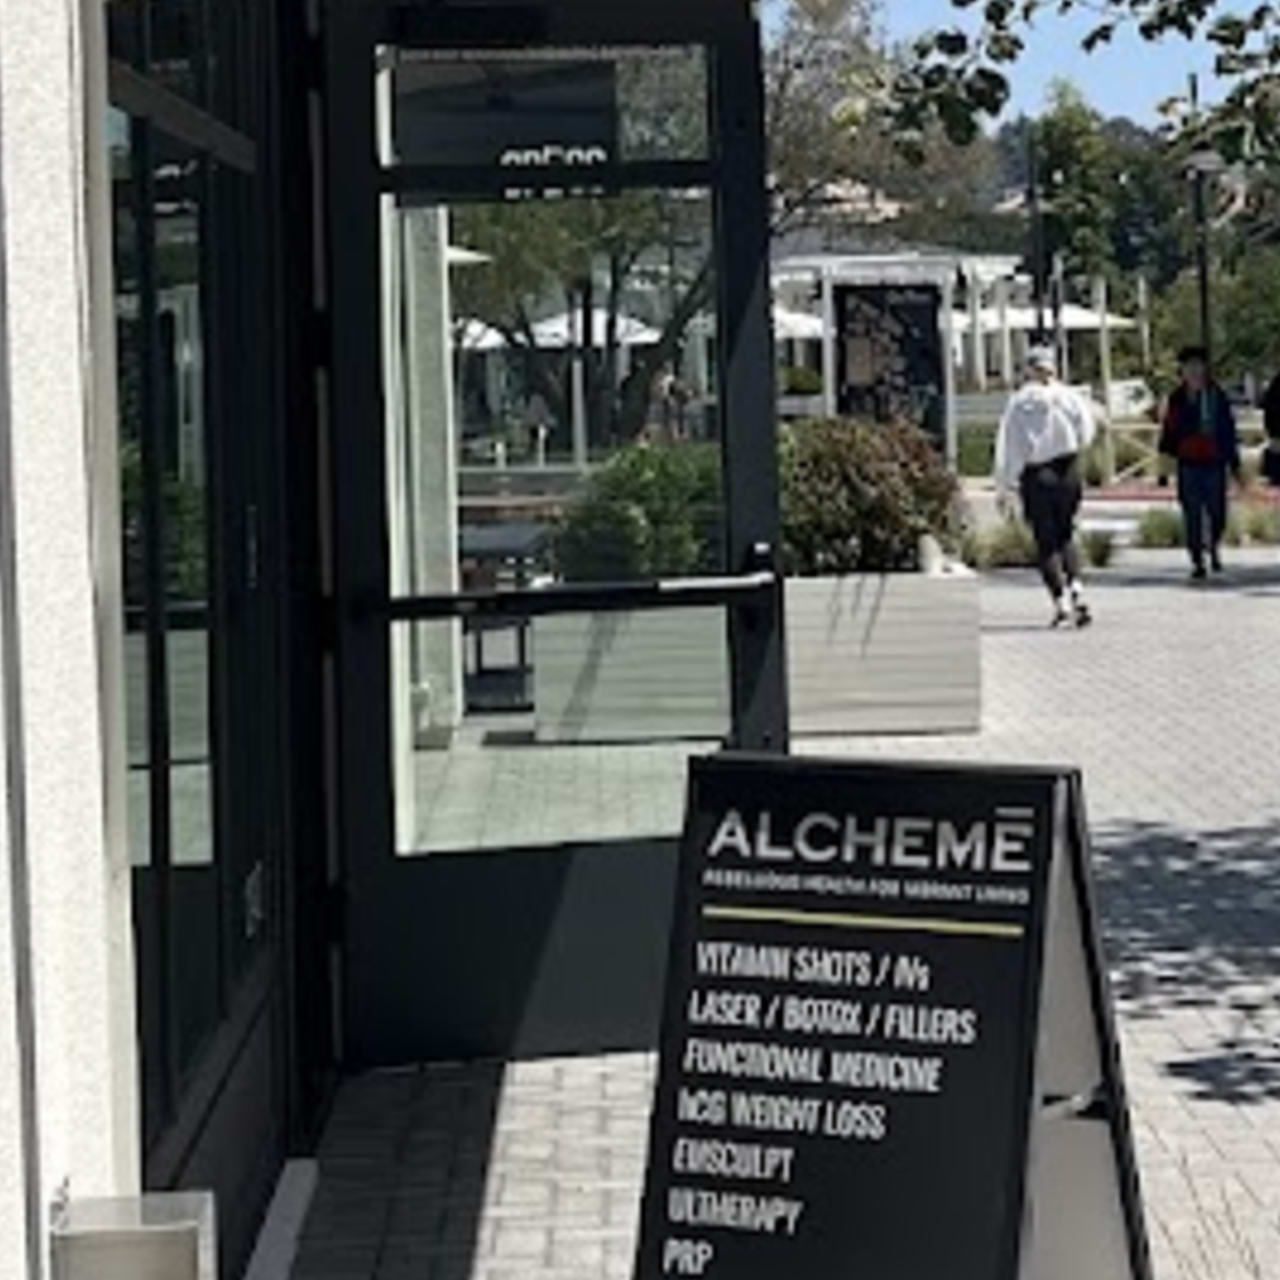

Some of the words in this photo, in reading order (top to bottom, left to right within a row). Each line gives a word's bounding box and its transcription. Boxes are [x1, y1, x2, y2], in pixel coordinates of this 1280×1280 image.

[696, 941, 791, 980] VITAMIN
[793, 946, 870, 986] SHOTS
[688, 990, 761, 1027] LASER
[783, 996, 862, 1035] BOTOX
[884, 1004, 976, 1044] FILLERS
[683, 1038, 822, 1082] FUNCTIONAL
[829, 1051, 943, 1092] MEDICINE
[730, 1091, 822, 1133] WEIGHT
[824, 1100, 886, 1140] LOSS
[668, 1187, 803, 1235] ULTHERAPY
[663, 1237, 713, 1275] PRP
